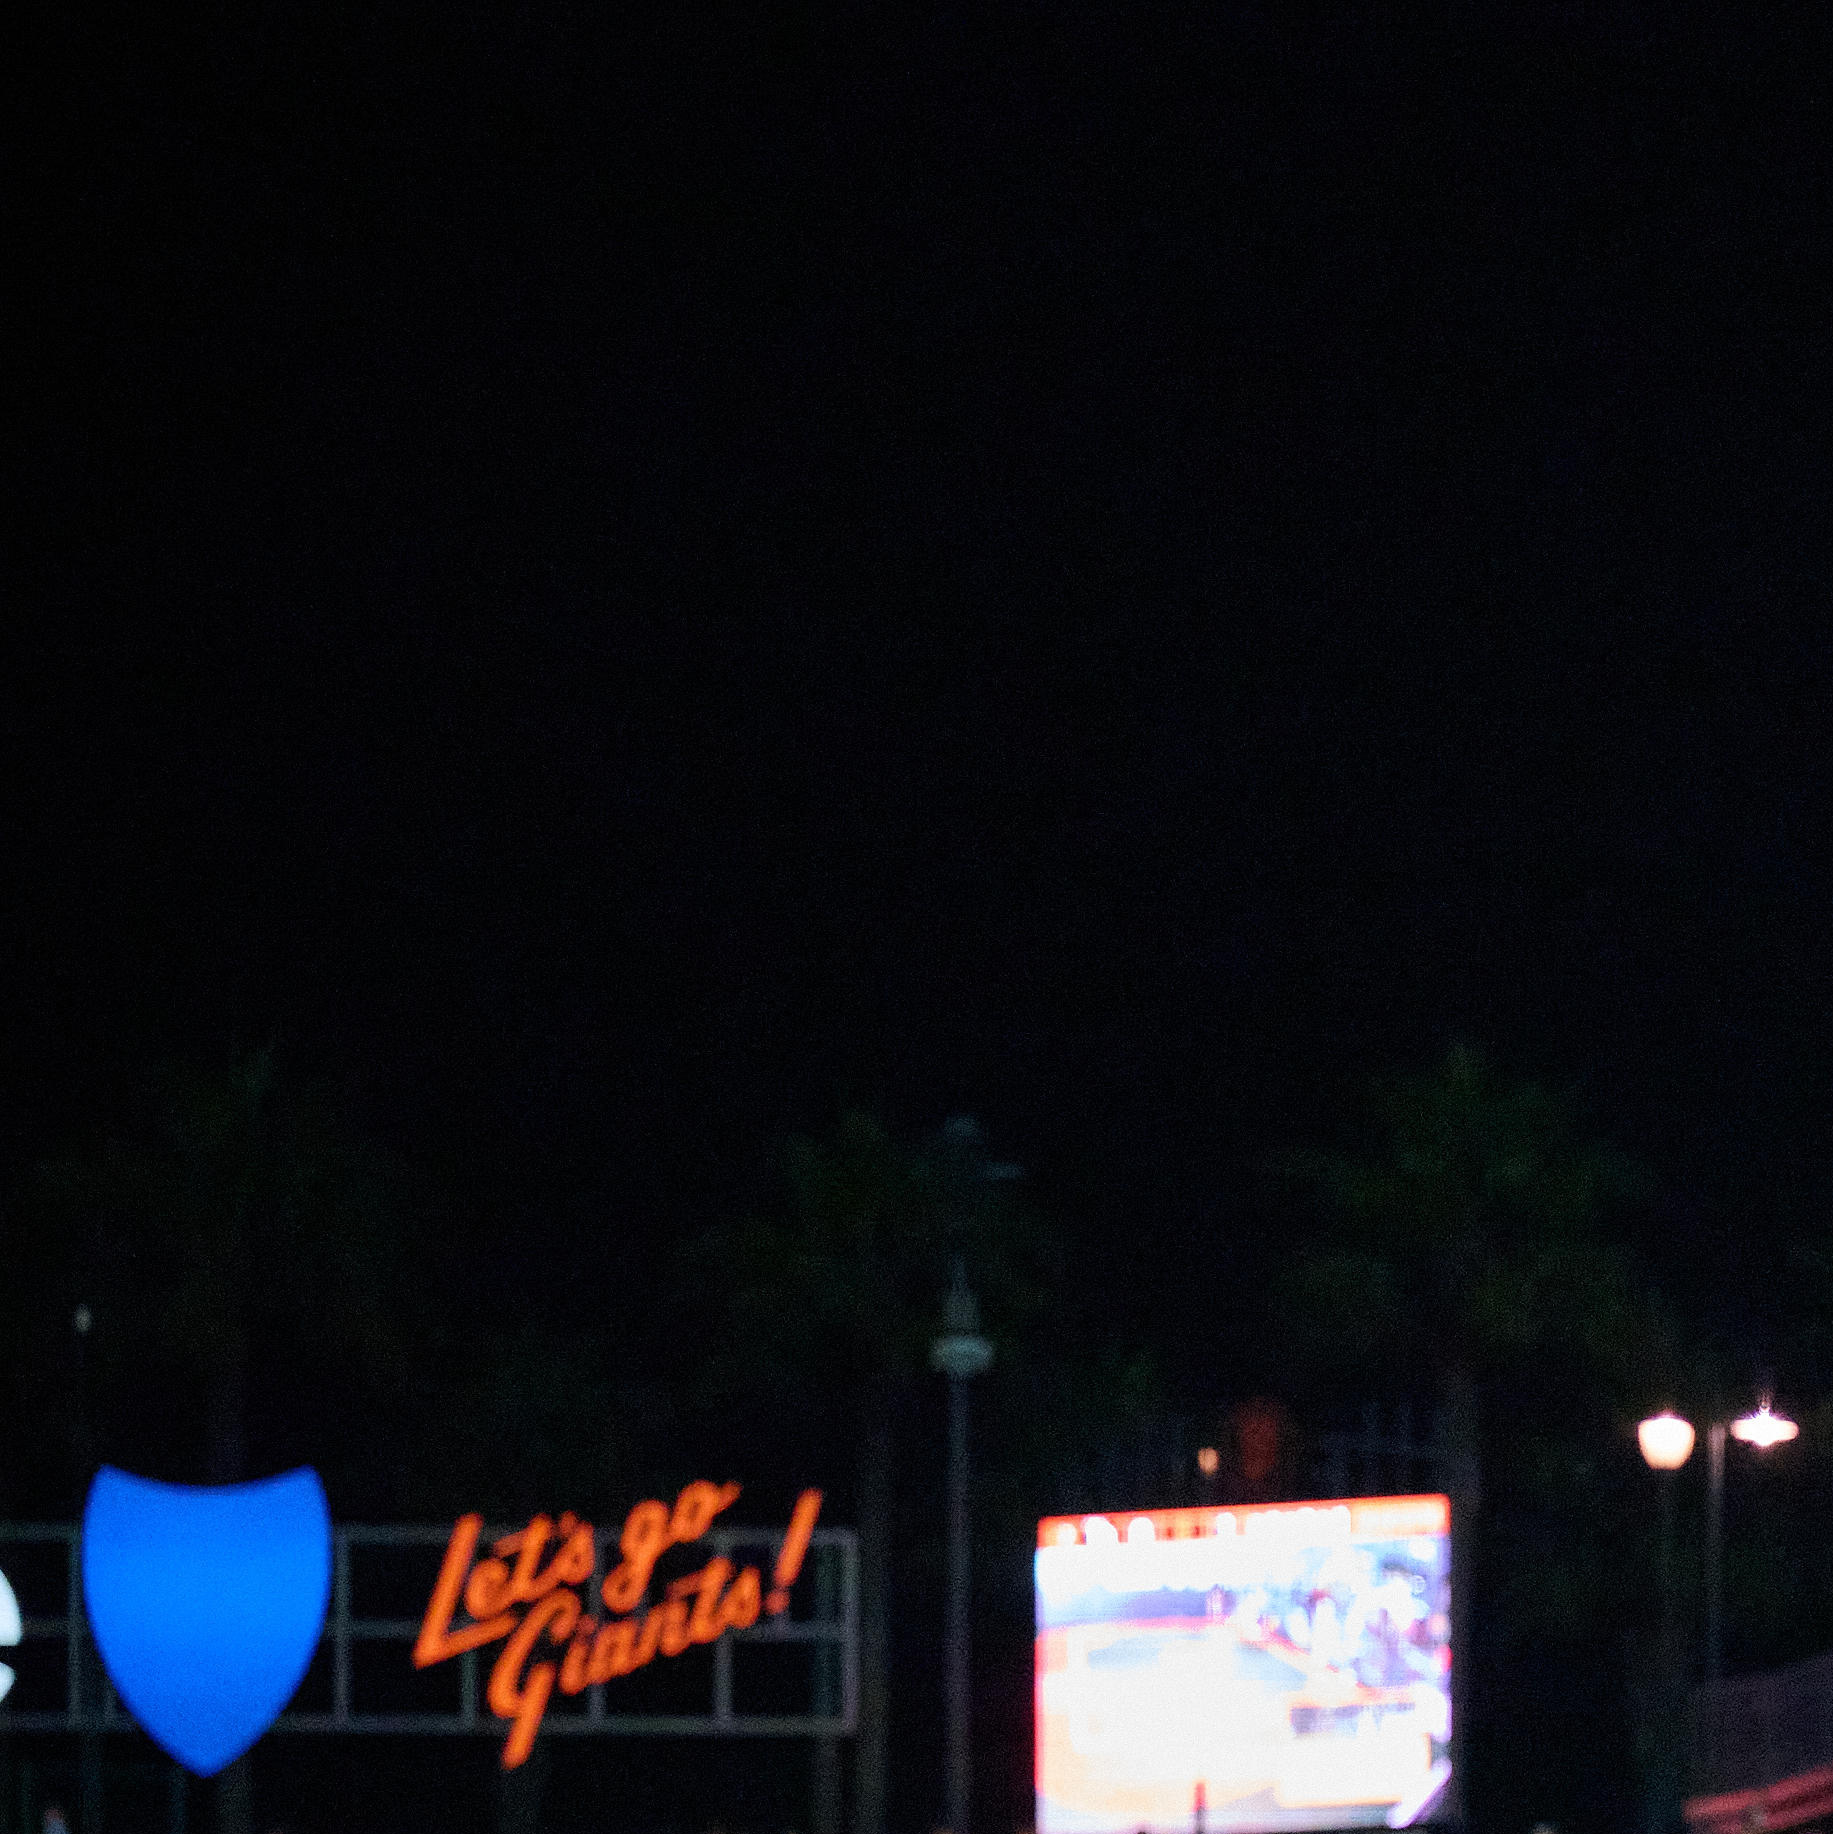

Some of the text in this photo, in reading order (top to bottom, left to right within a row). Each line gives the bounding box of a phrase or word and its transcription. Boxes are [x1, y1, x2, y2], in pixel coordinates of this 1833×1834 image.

[413, 1480, 742, 1670] Let's go
[487, 1487, 823, 1771] Giants!
